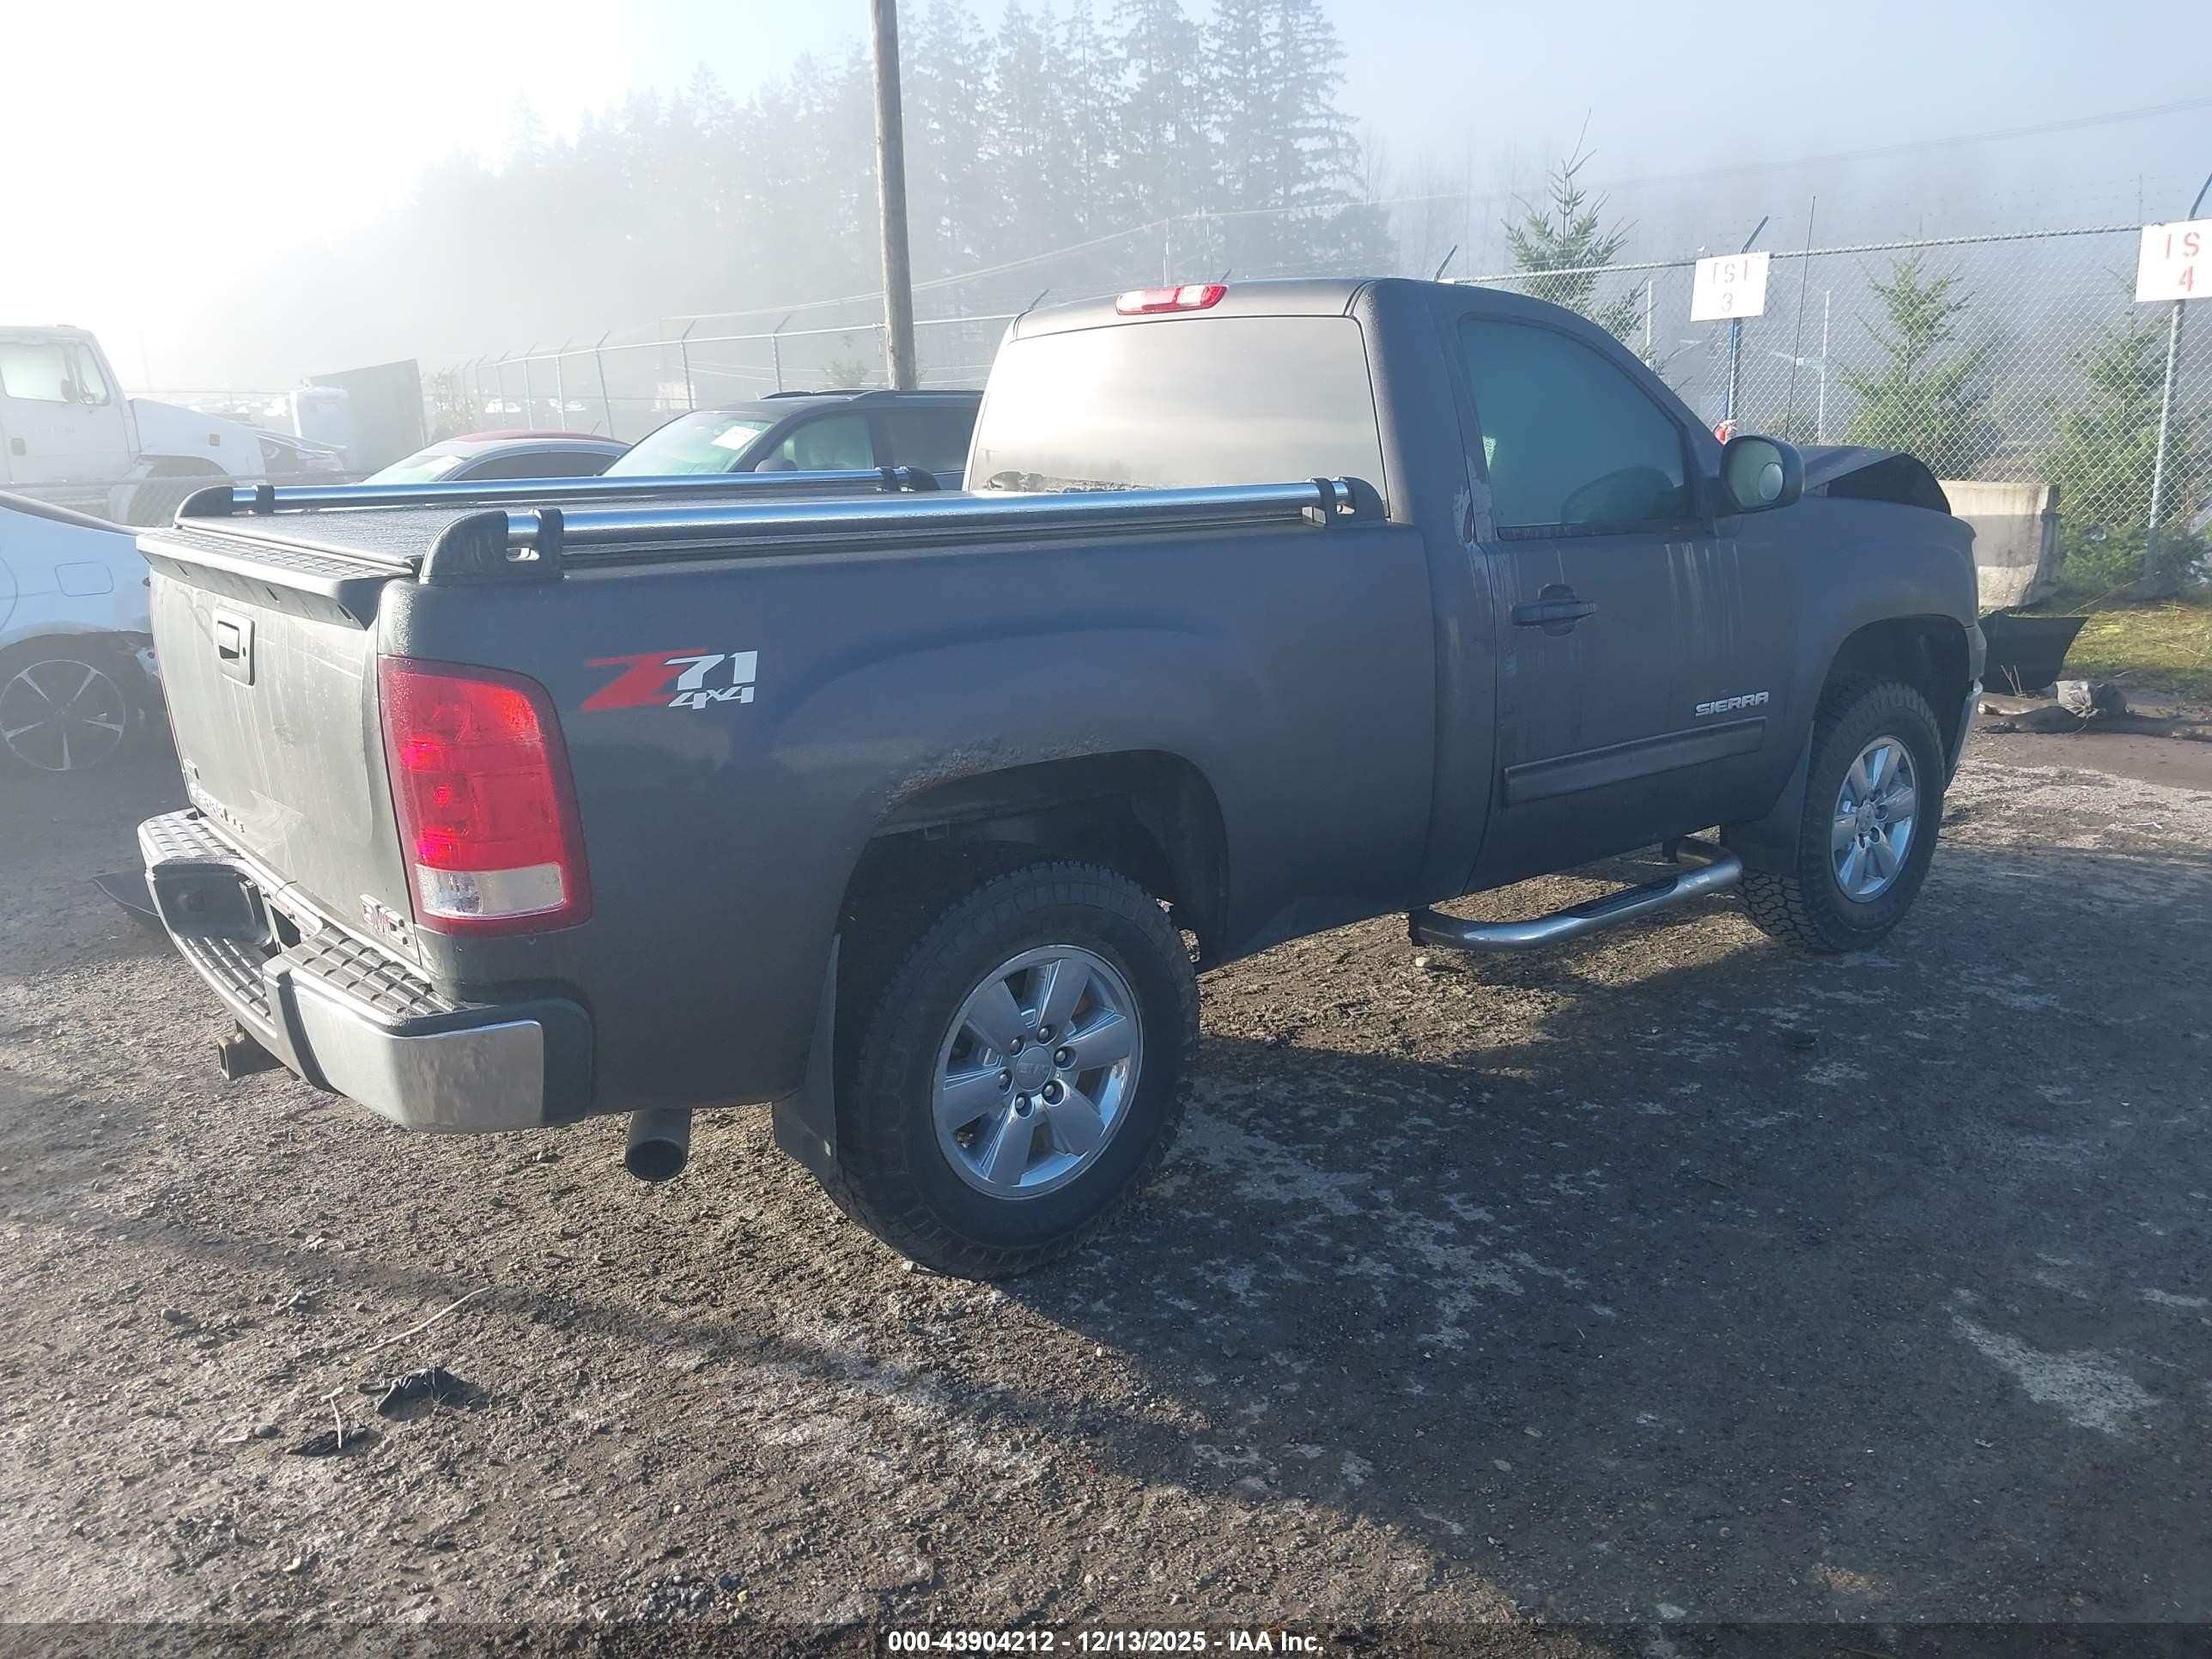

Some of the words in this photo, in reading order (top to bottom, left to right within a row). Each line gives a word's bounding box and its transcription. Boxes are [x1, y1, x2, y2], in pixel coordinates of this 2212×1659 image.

[2178, 265, 2194, 292] 4
[1722, 292, 1733, 312] 3
[580, 647, 758, 712] Z71
[1695, 690, 1770, 718] SIERRA
